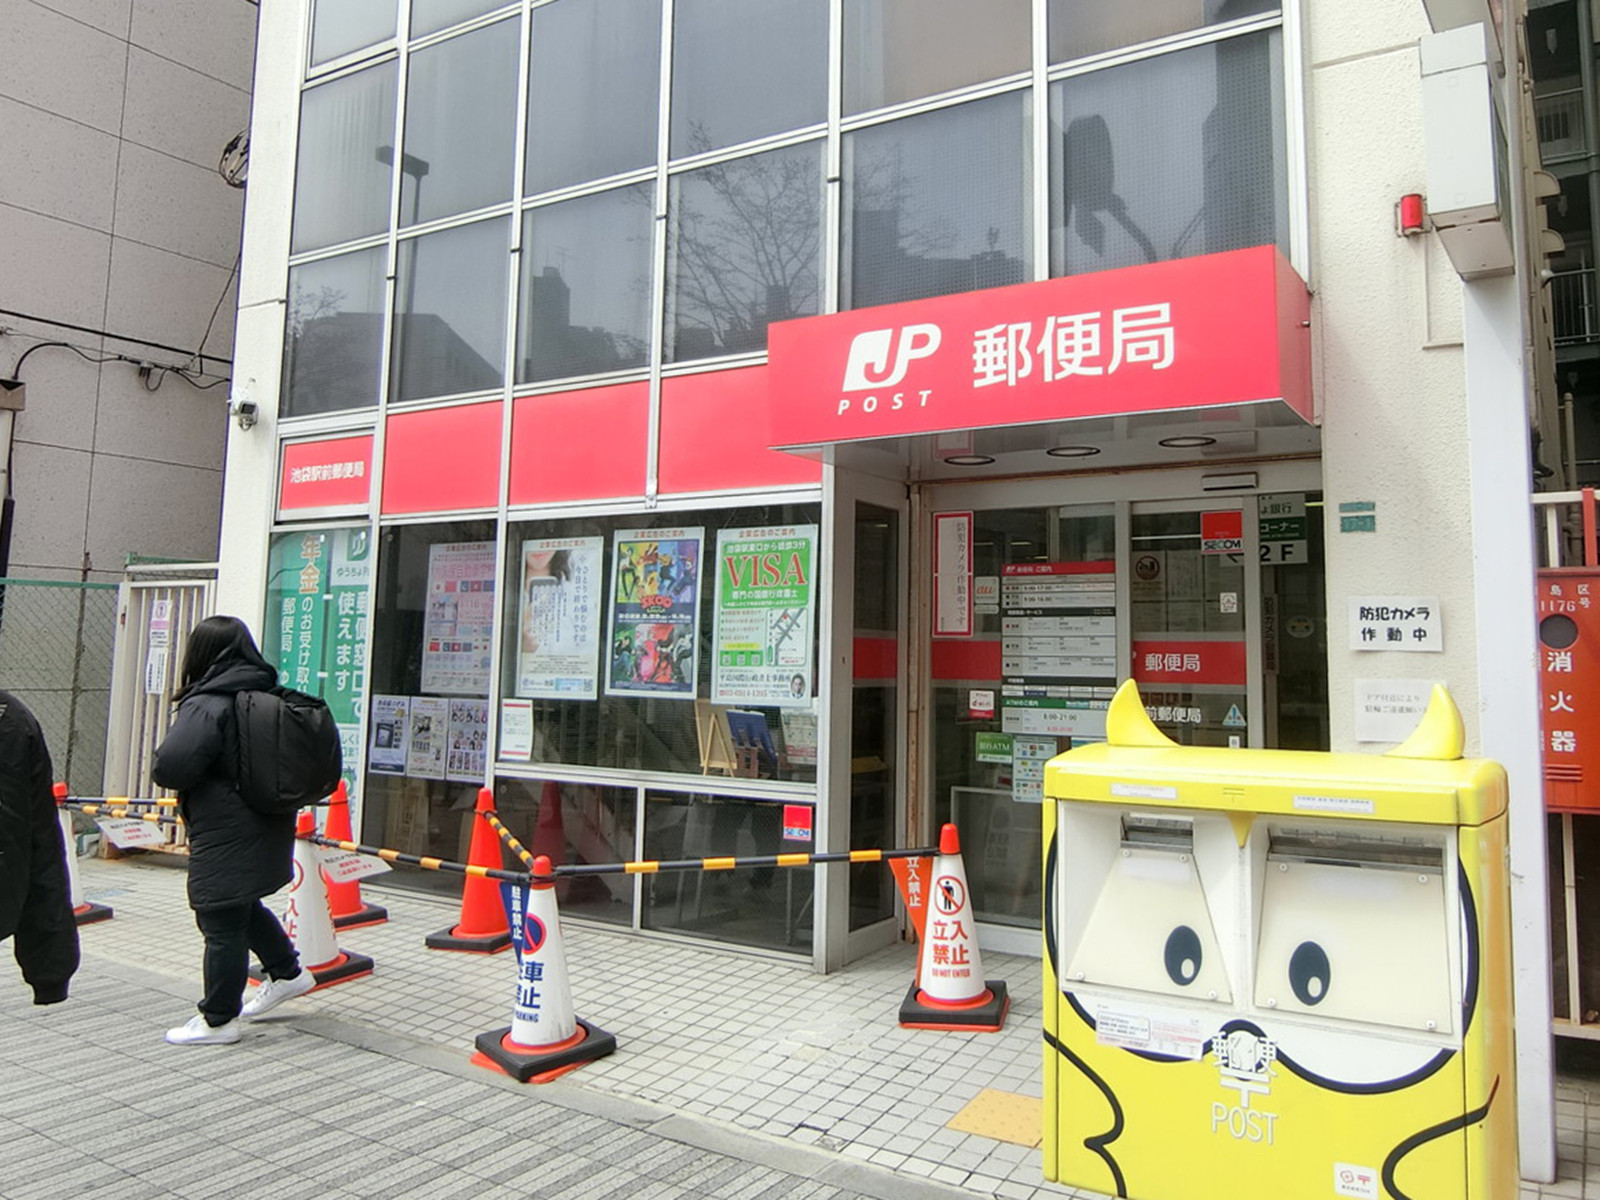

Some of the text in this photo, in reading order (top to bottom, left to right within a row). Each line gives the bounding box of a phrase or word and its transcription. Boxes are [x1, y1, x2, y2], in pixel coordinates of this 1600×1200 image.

[973, 302, 1175, 388] 郵便局
[837, 389, 933, 416] POST
[290, 460, 365, 483] 池袋駅前郵便局
[1204, 538, 1241, 551] SECOM
[724, 551, 807, 588] VISA
[956, 522, 966, 626] 防犯カメラ作動中です
[1359, 606, 1431, 622] 防犯カメラ
[334, 591, 356, 692] 使えます
[1361, 627, 1428, 642] 作動中
[1145, 653, 1201, 672] 郵便局
[1547, 651, 1577, 753] 消火器
[907, 857, 922, 907] 立入禁止
[512, 886, 523, 940] 駐車禁止
[932, 919, 968, 941] 立入
[933, 944, 970, 965] 禁止
[1212, 1101, 1279, 1146] POST
